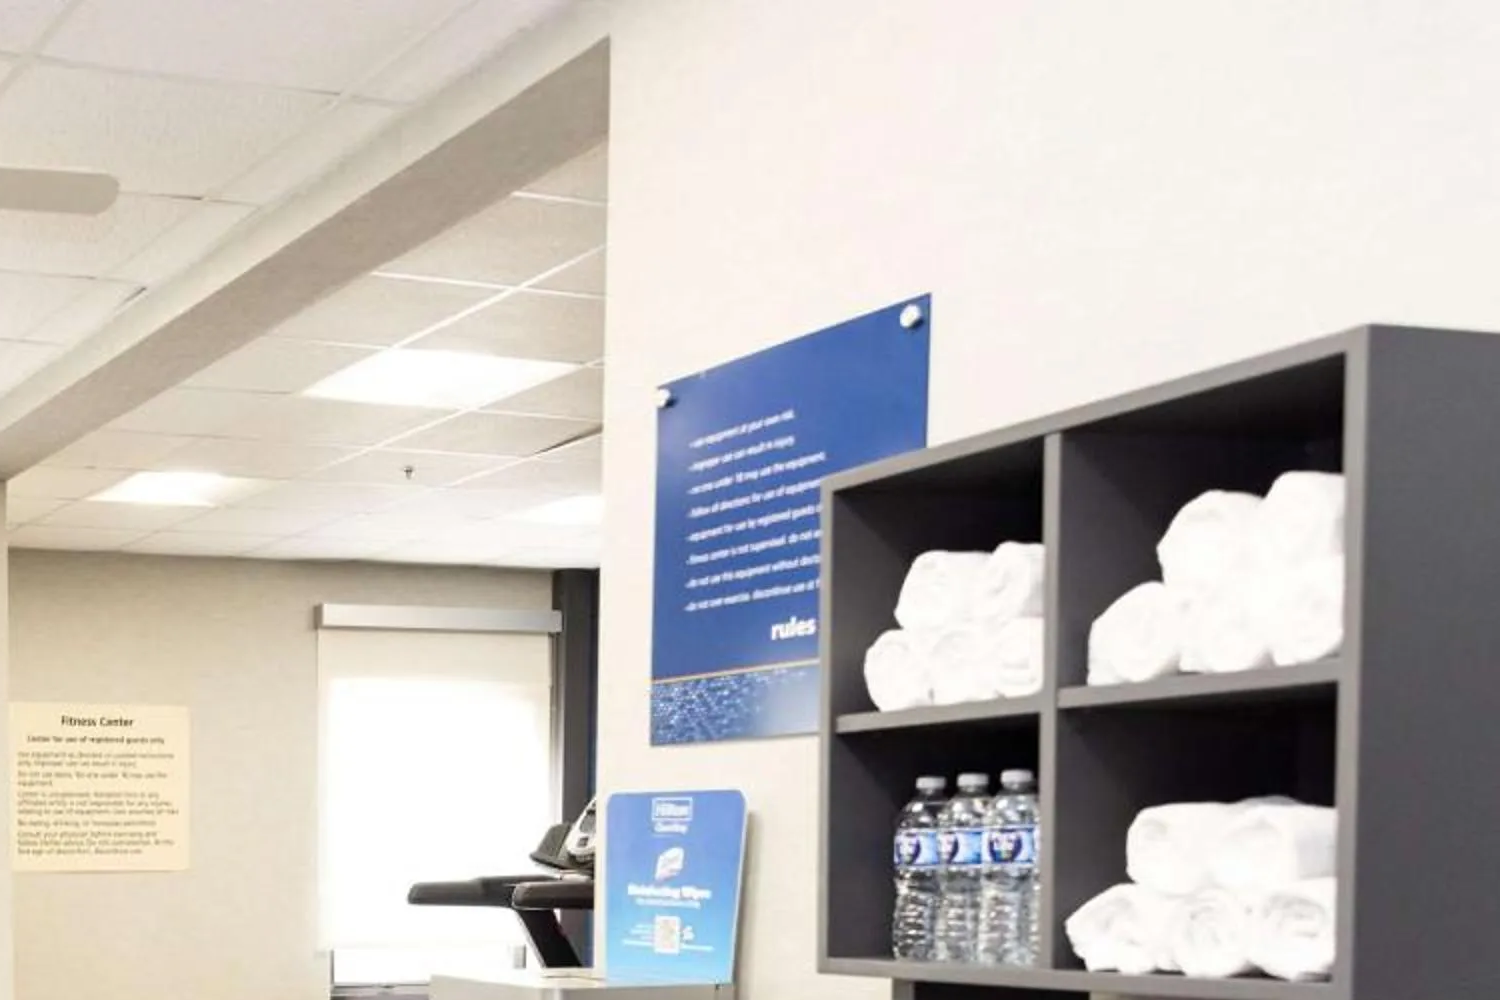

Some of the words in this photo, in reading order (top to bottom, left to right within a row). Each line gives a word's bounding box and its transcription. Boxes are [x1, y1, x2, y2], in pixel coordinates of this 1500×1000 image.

[770, 615, 816, 640] rules
[61, 716, 96, 727] Fitness
[100, 717, 134, 727] Center
